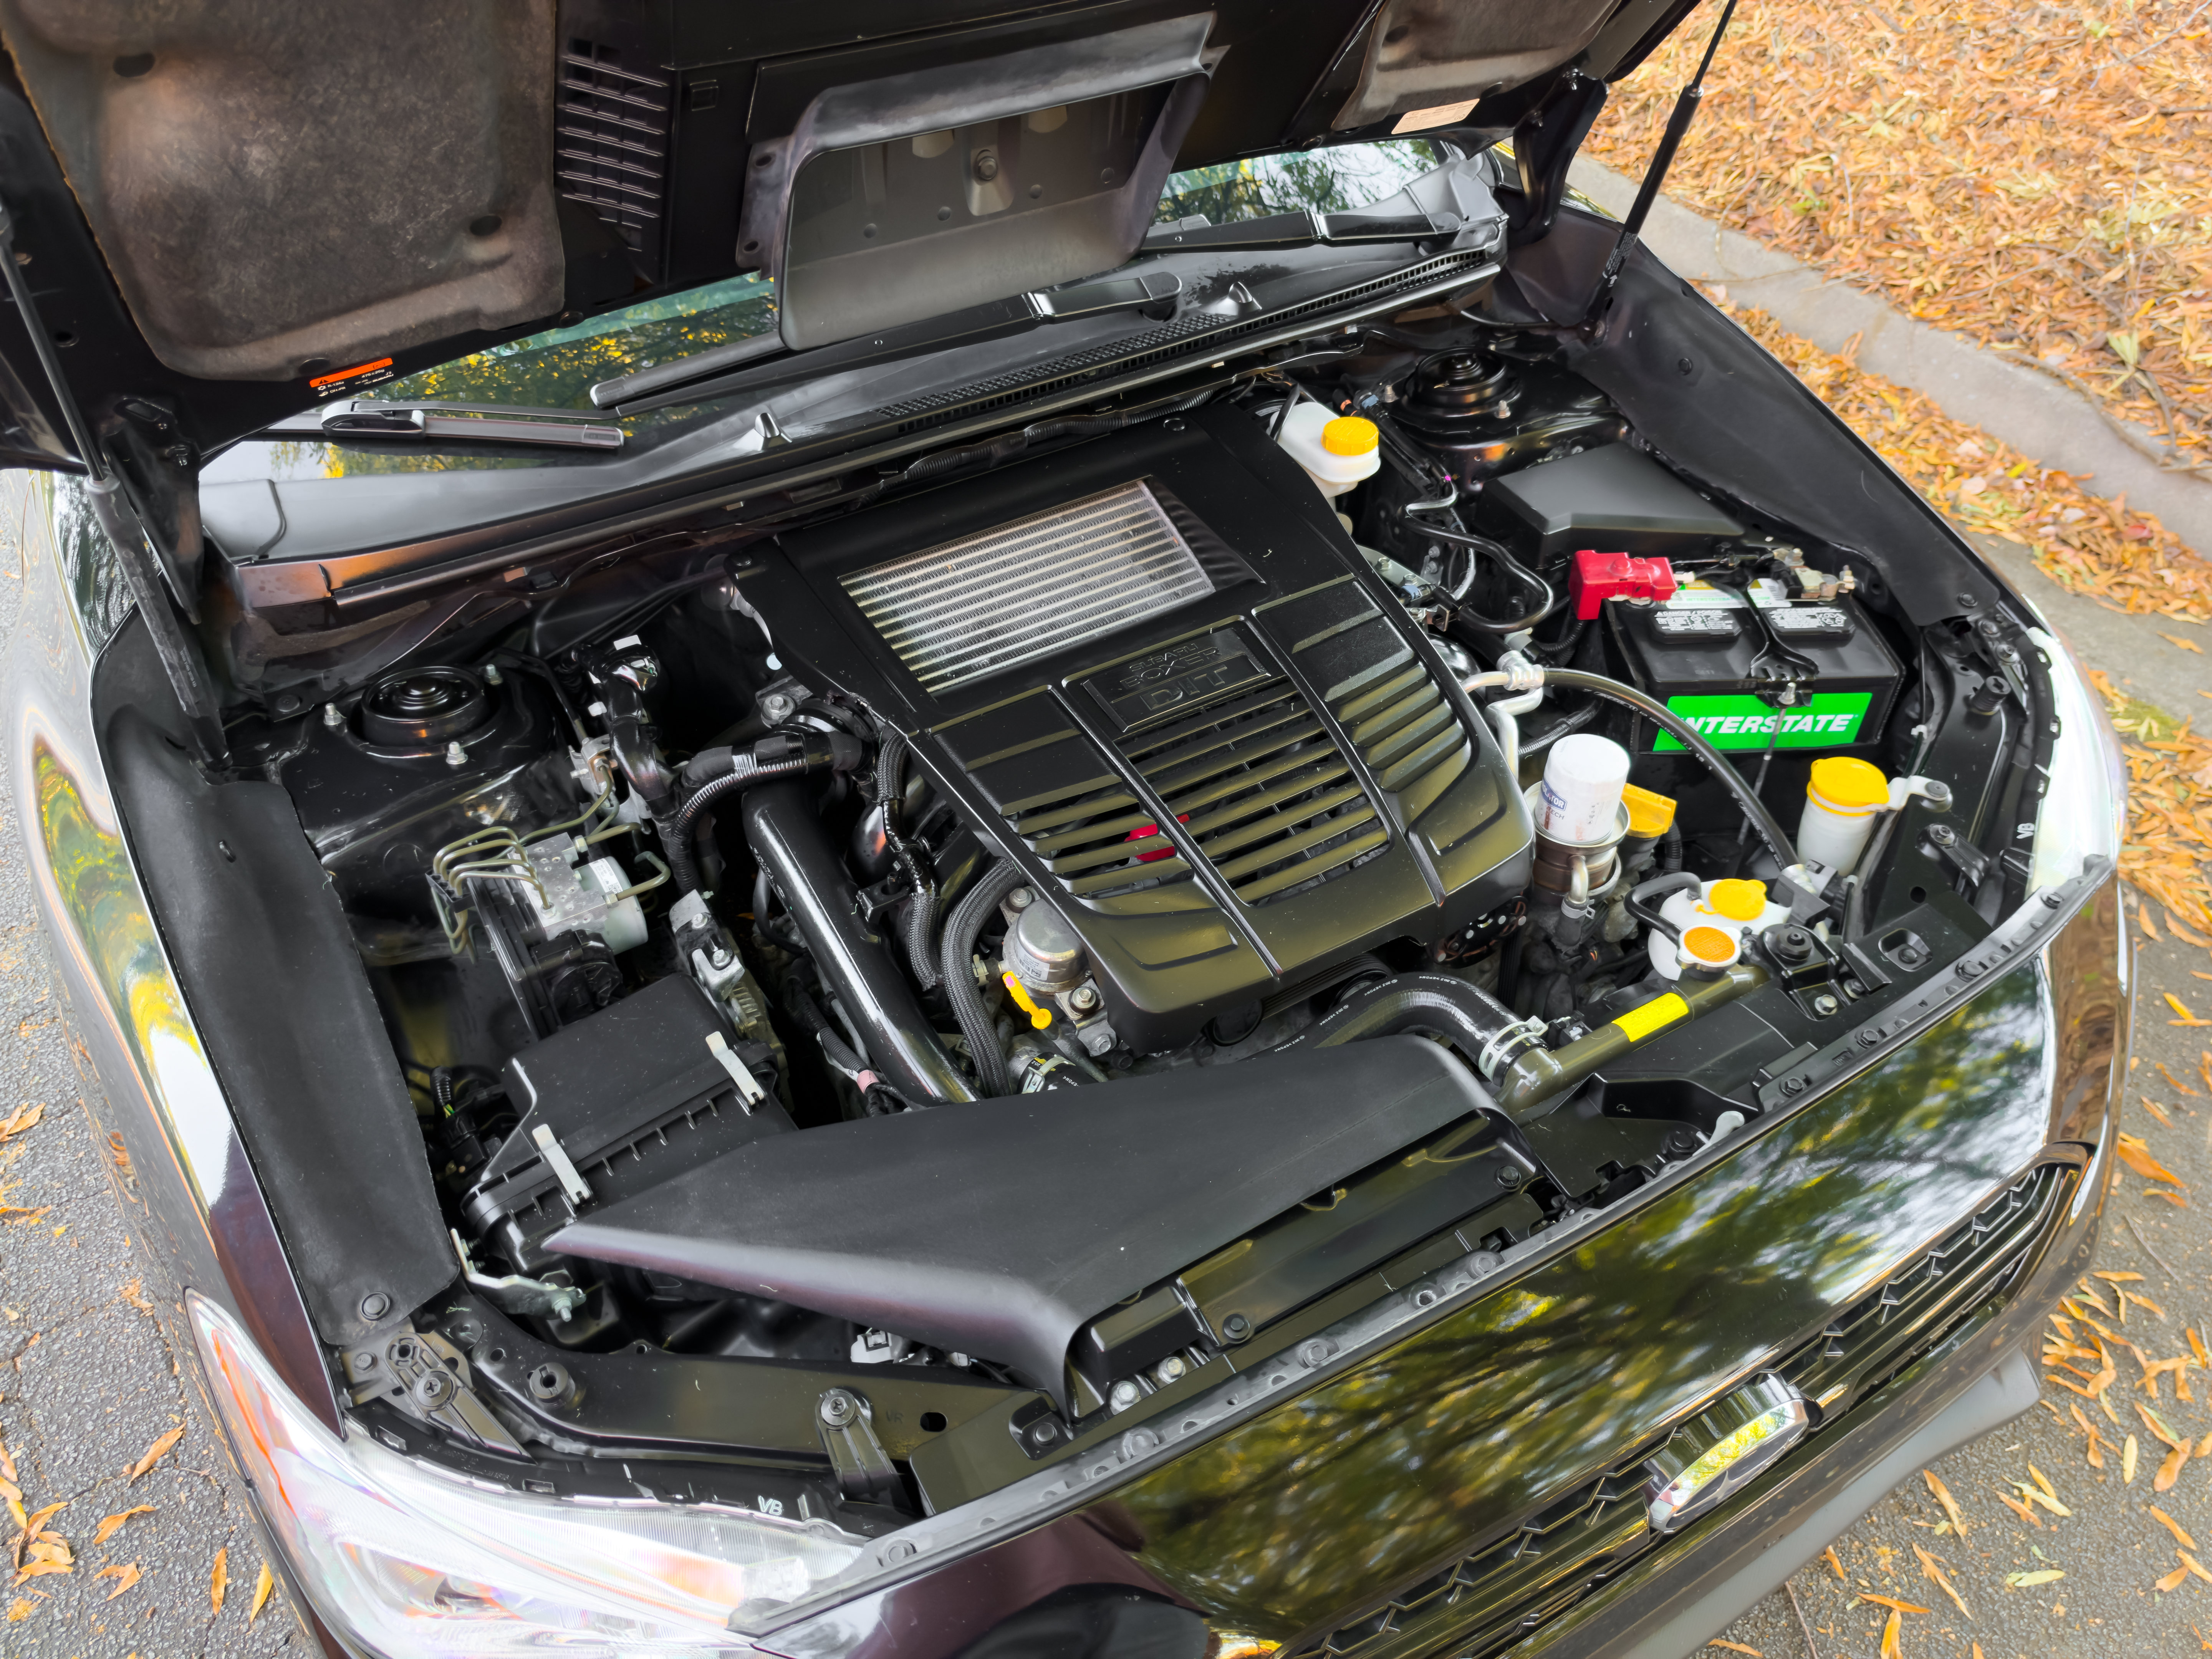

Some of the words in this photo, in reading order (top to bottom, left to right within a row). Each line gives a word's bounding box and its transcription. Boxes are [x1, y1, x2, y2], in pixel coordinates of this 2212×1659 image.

[1119, 646, 1223, 690] BOXER
[1129, 643, 1199, 672] SUBARU
[1139, 664, 1228, 711] DIT
[1681, 714, 1854, 734] NTERSTATE
[758, 1495, 782, 1516] VB
